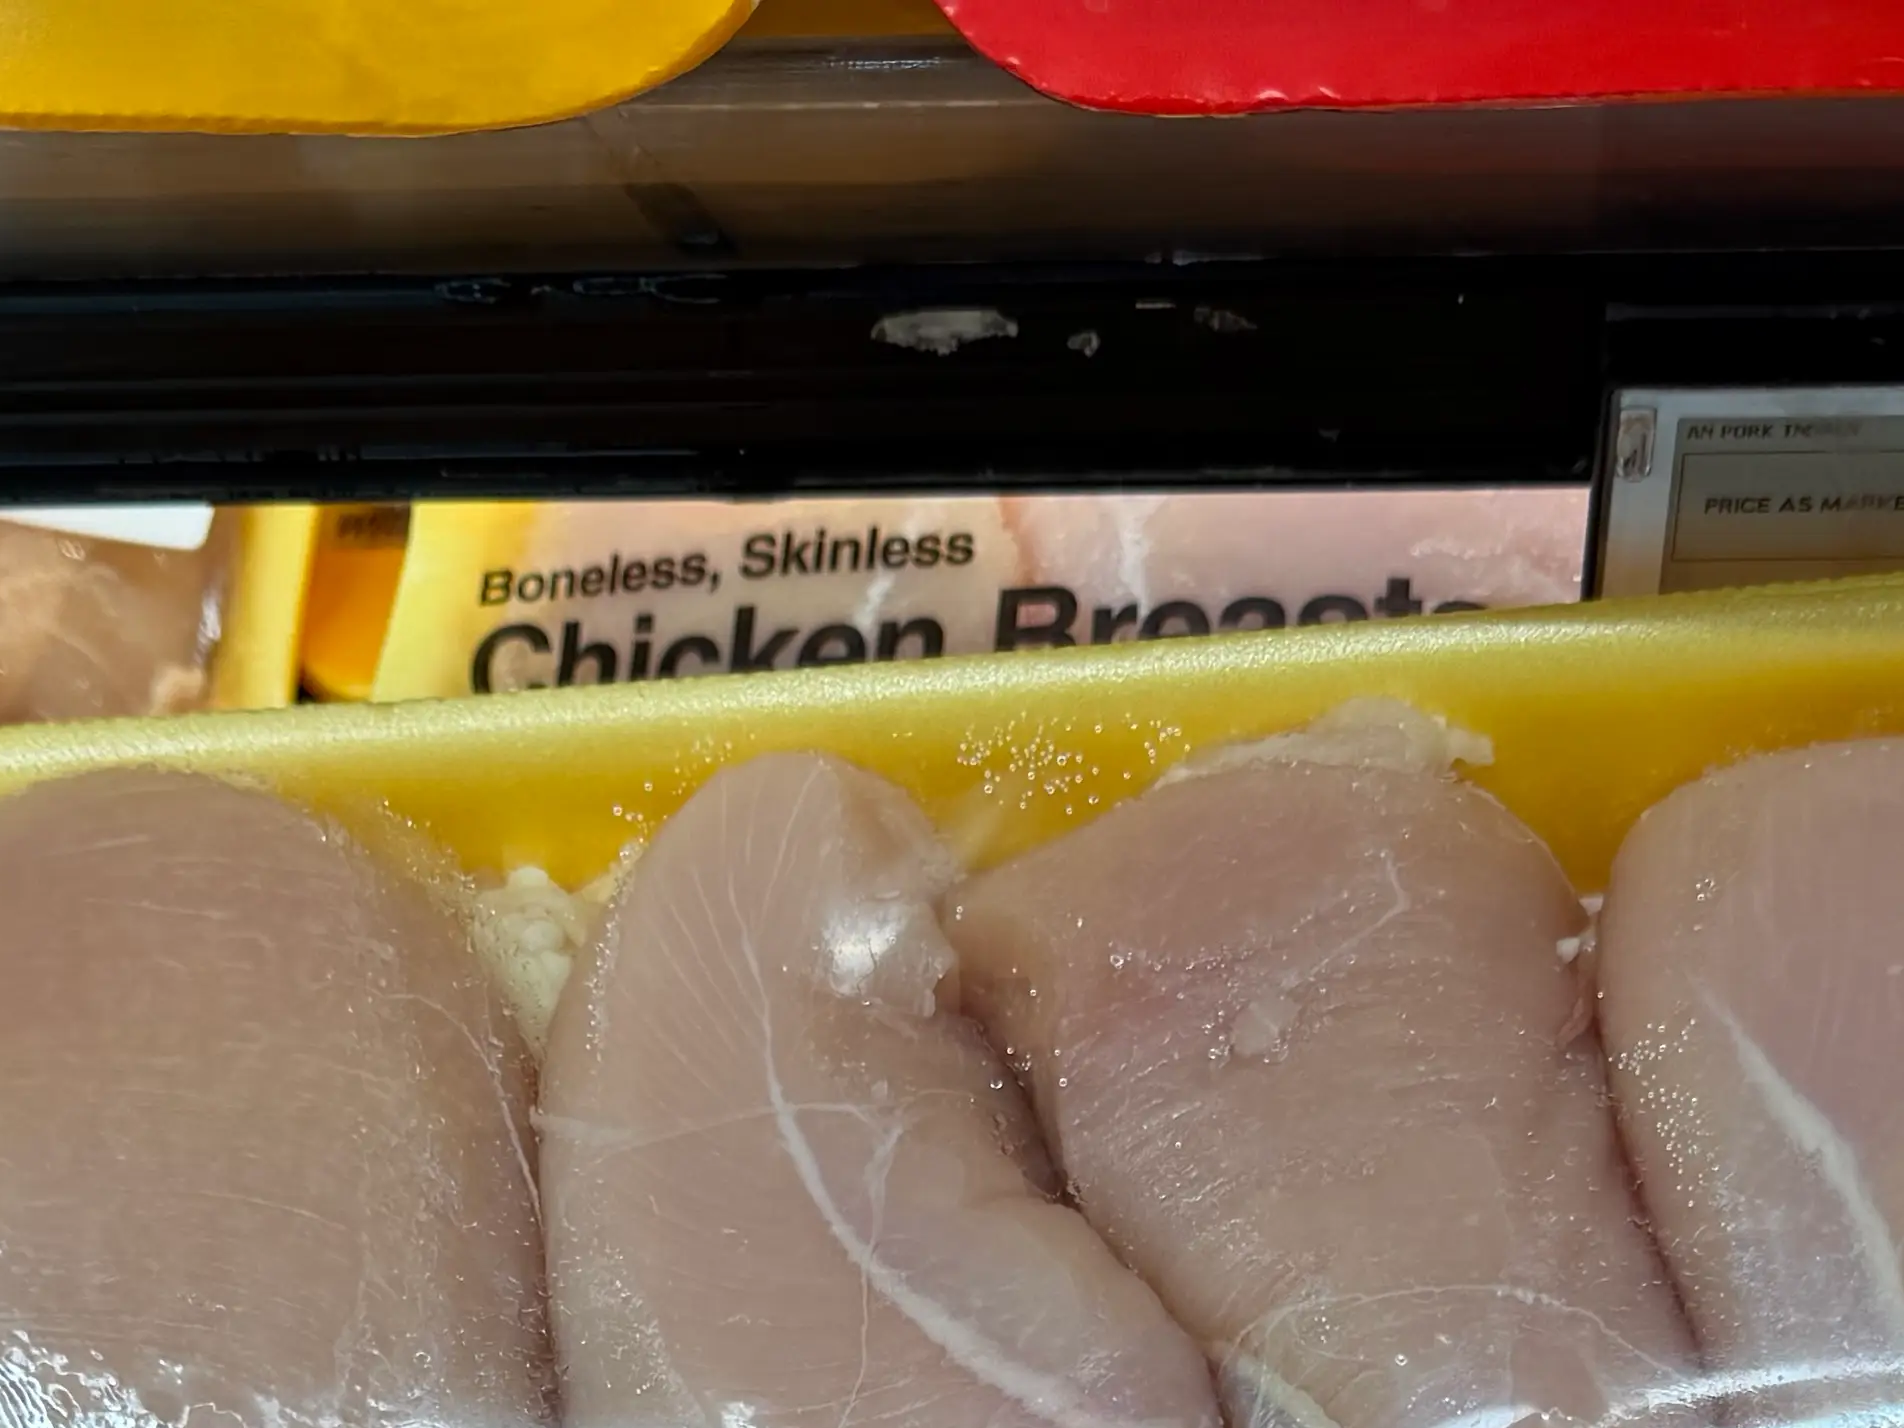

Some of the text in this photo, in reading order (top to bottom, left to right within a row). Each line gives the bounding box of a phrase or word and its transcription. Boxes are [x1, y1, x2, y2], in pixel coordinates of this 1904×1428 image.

[1705, 497, 1770, 514] PRICE
[1779, 497, 1812, 513] AS
[480, 524, 974, 606] Boneless, Skinless
